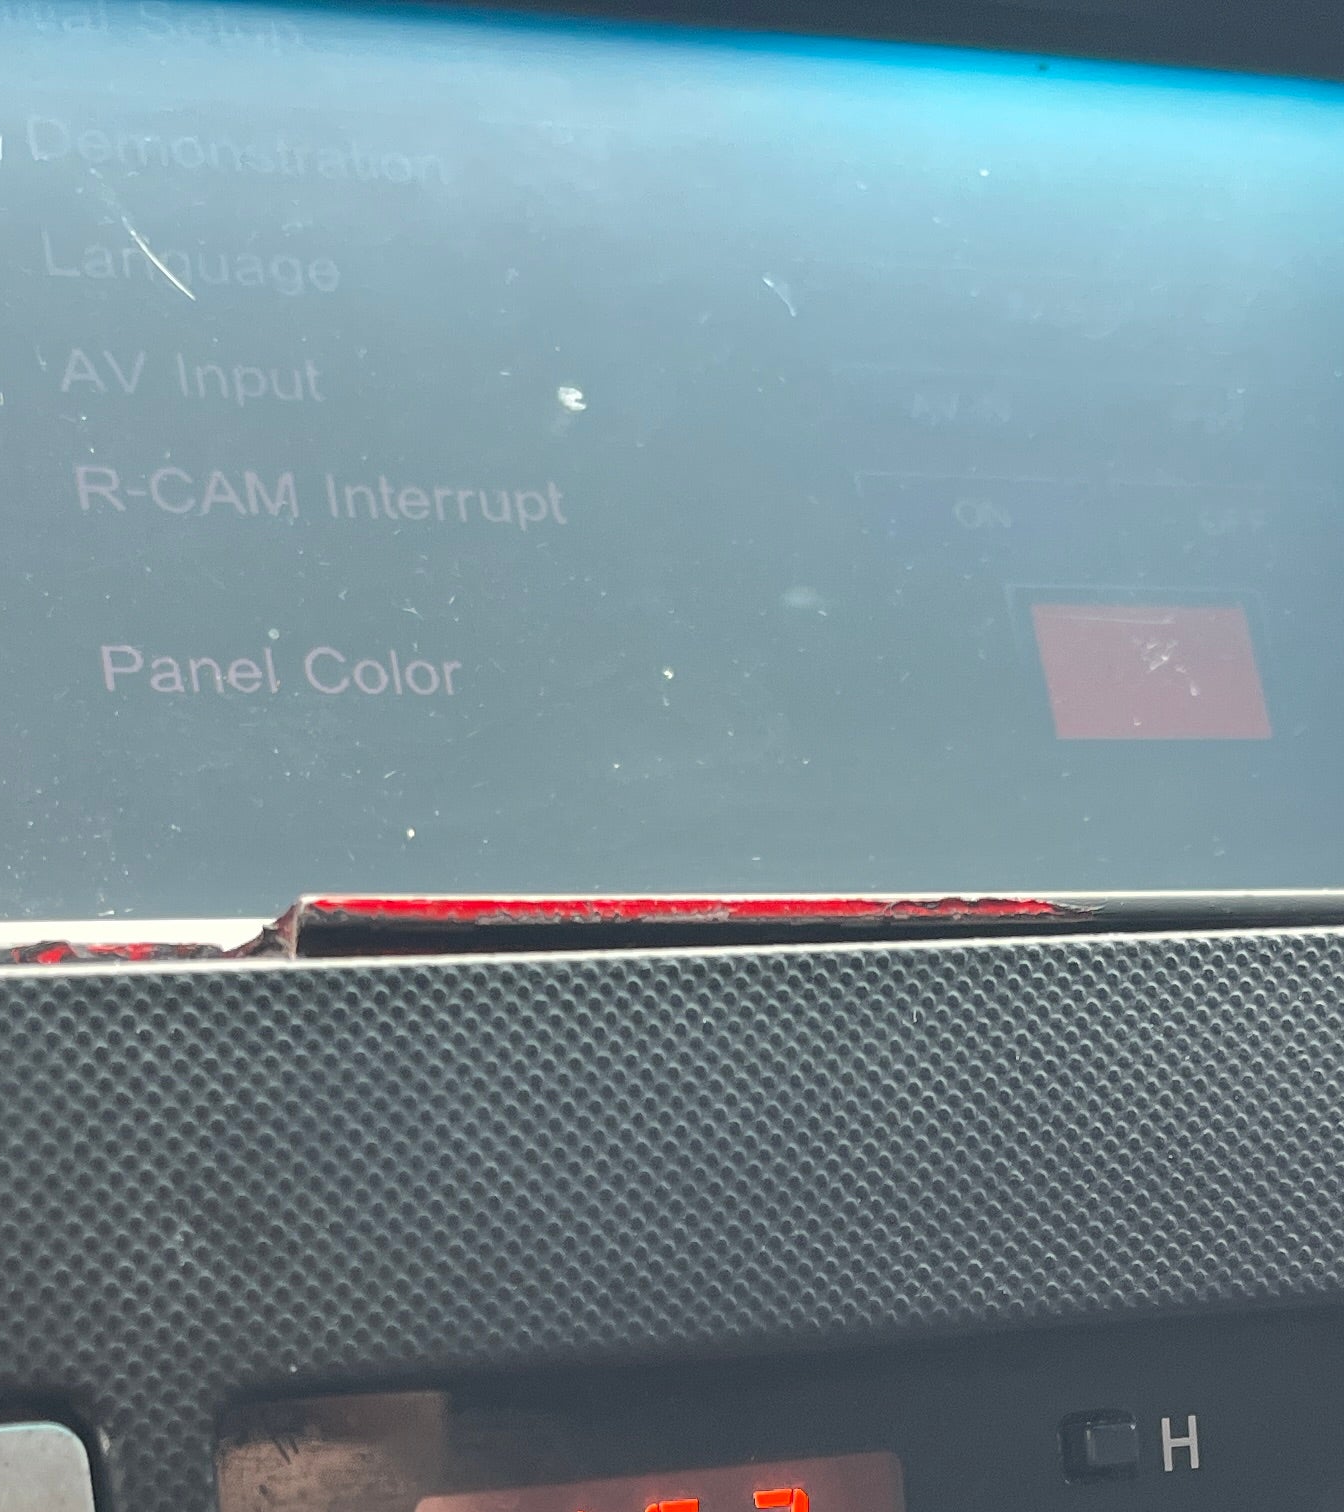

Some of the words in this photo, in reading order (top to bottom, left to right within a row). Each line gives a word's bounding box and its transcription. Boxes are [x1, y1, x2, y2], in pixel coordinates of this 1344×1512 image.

[25, 114, 450, 187] Demonstration
[41, 229, 342, 296] Language
[60, 347, 148, 395] AV
[176, 352, 328, 406] Input
[73, 464, 299, 518] R-CAM
[325, 474, 568, 531] Interrupt
[99, 645, 280, 695] Panel
[303, 645, 461, 696] Color
[1161, 1414, 1200, 1472] H
